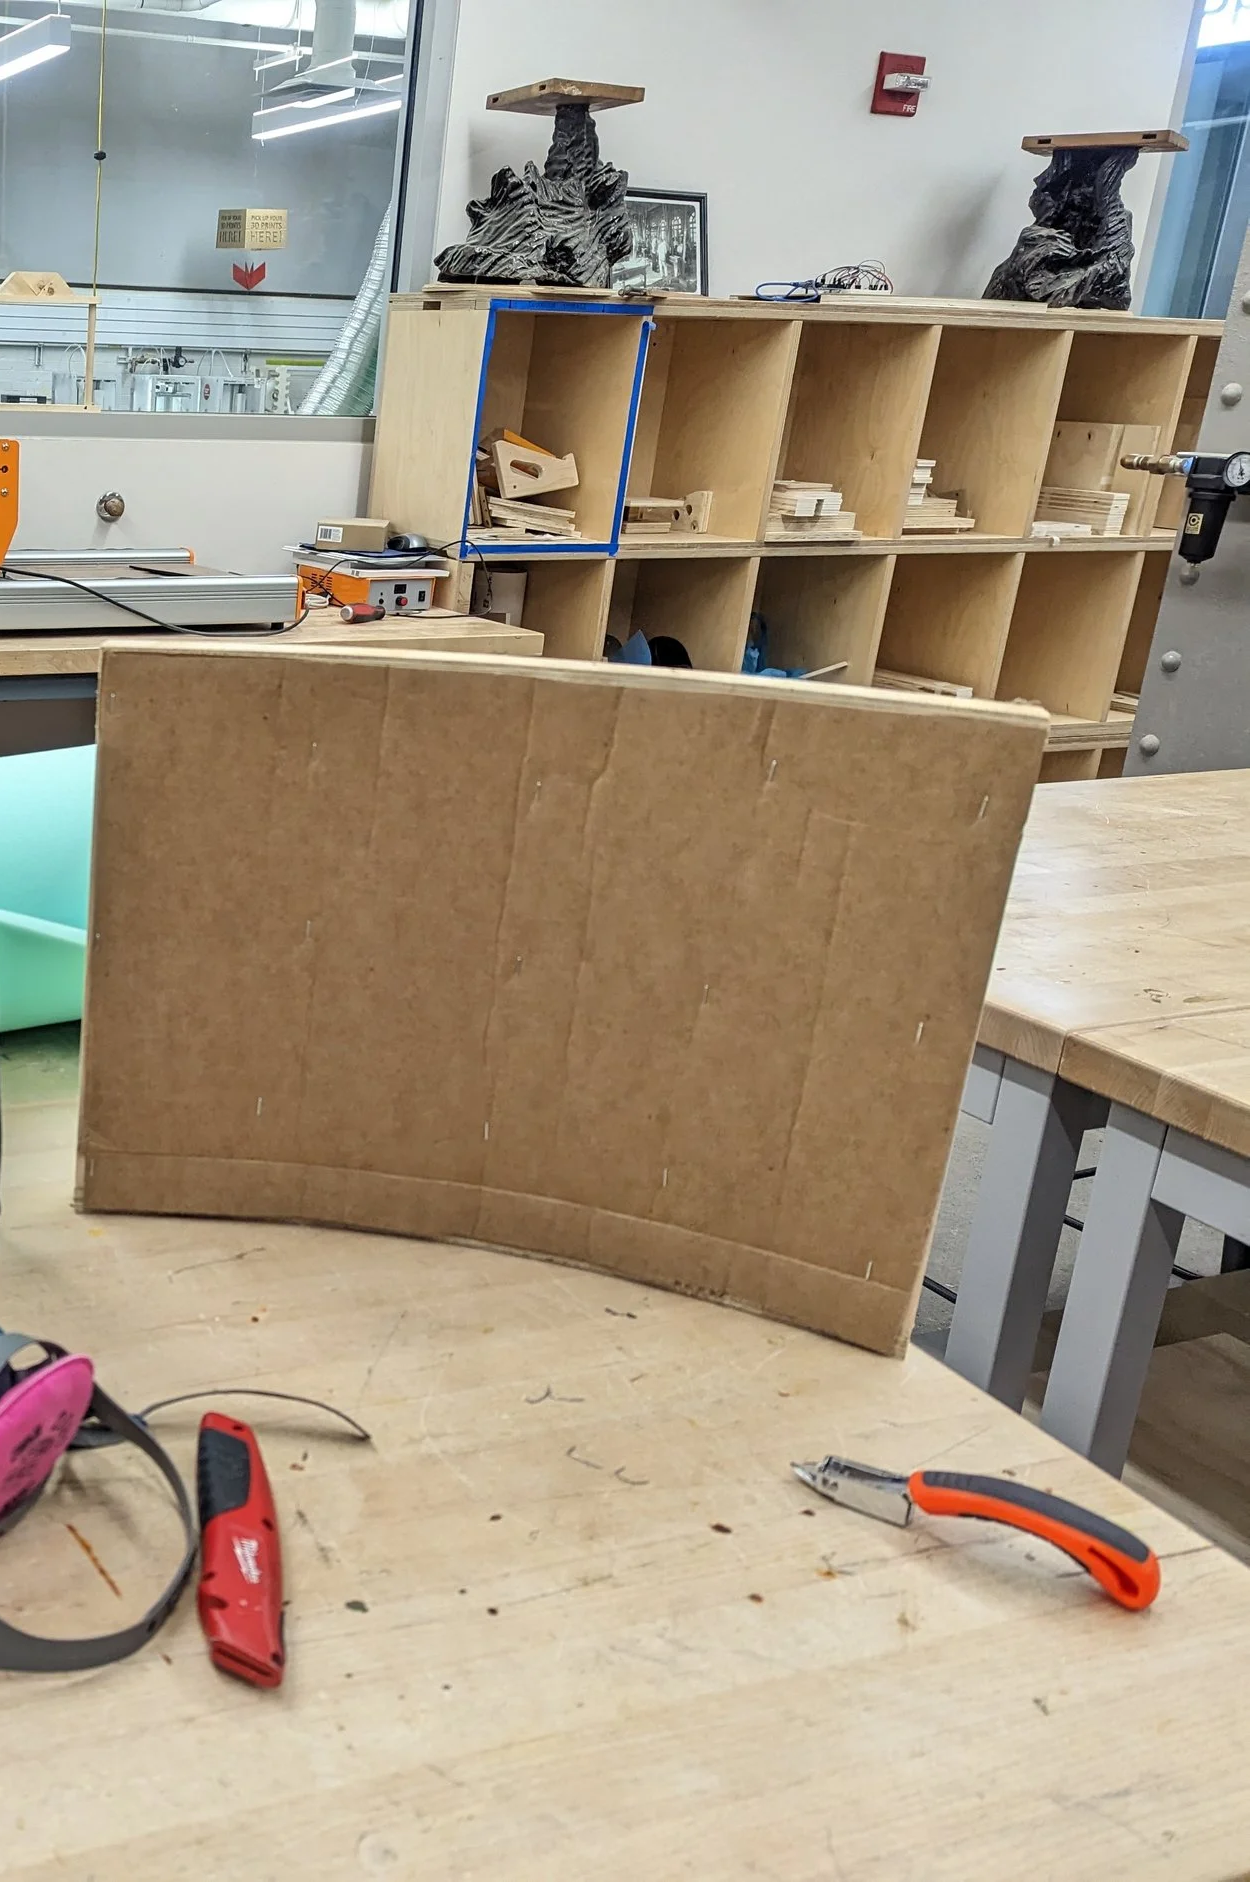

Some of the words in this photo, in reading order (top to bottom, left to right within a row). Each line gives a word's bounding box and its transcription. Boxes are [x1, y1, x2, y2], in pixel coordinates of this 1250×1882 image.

[902, 104, 916, 112] FIRE
[261, 222, 282, 230] PRINTS
[250, 231, 282, 243] HERE!
